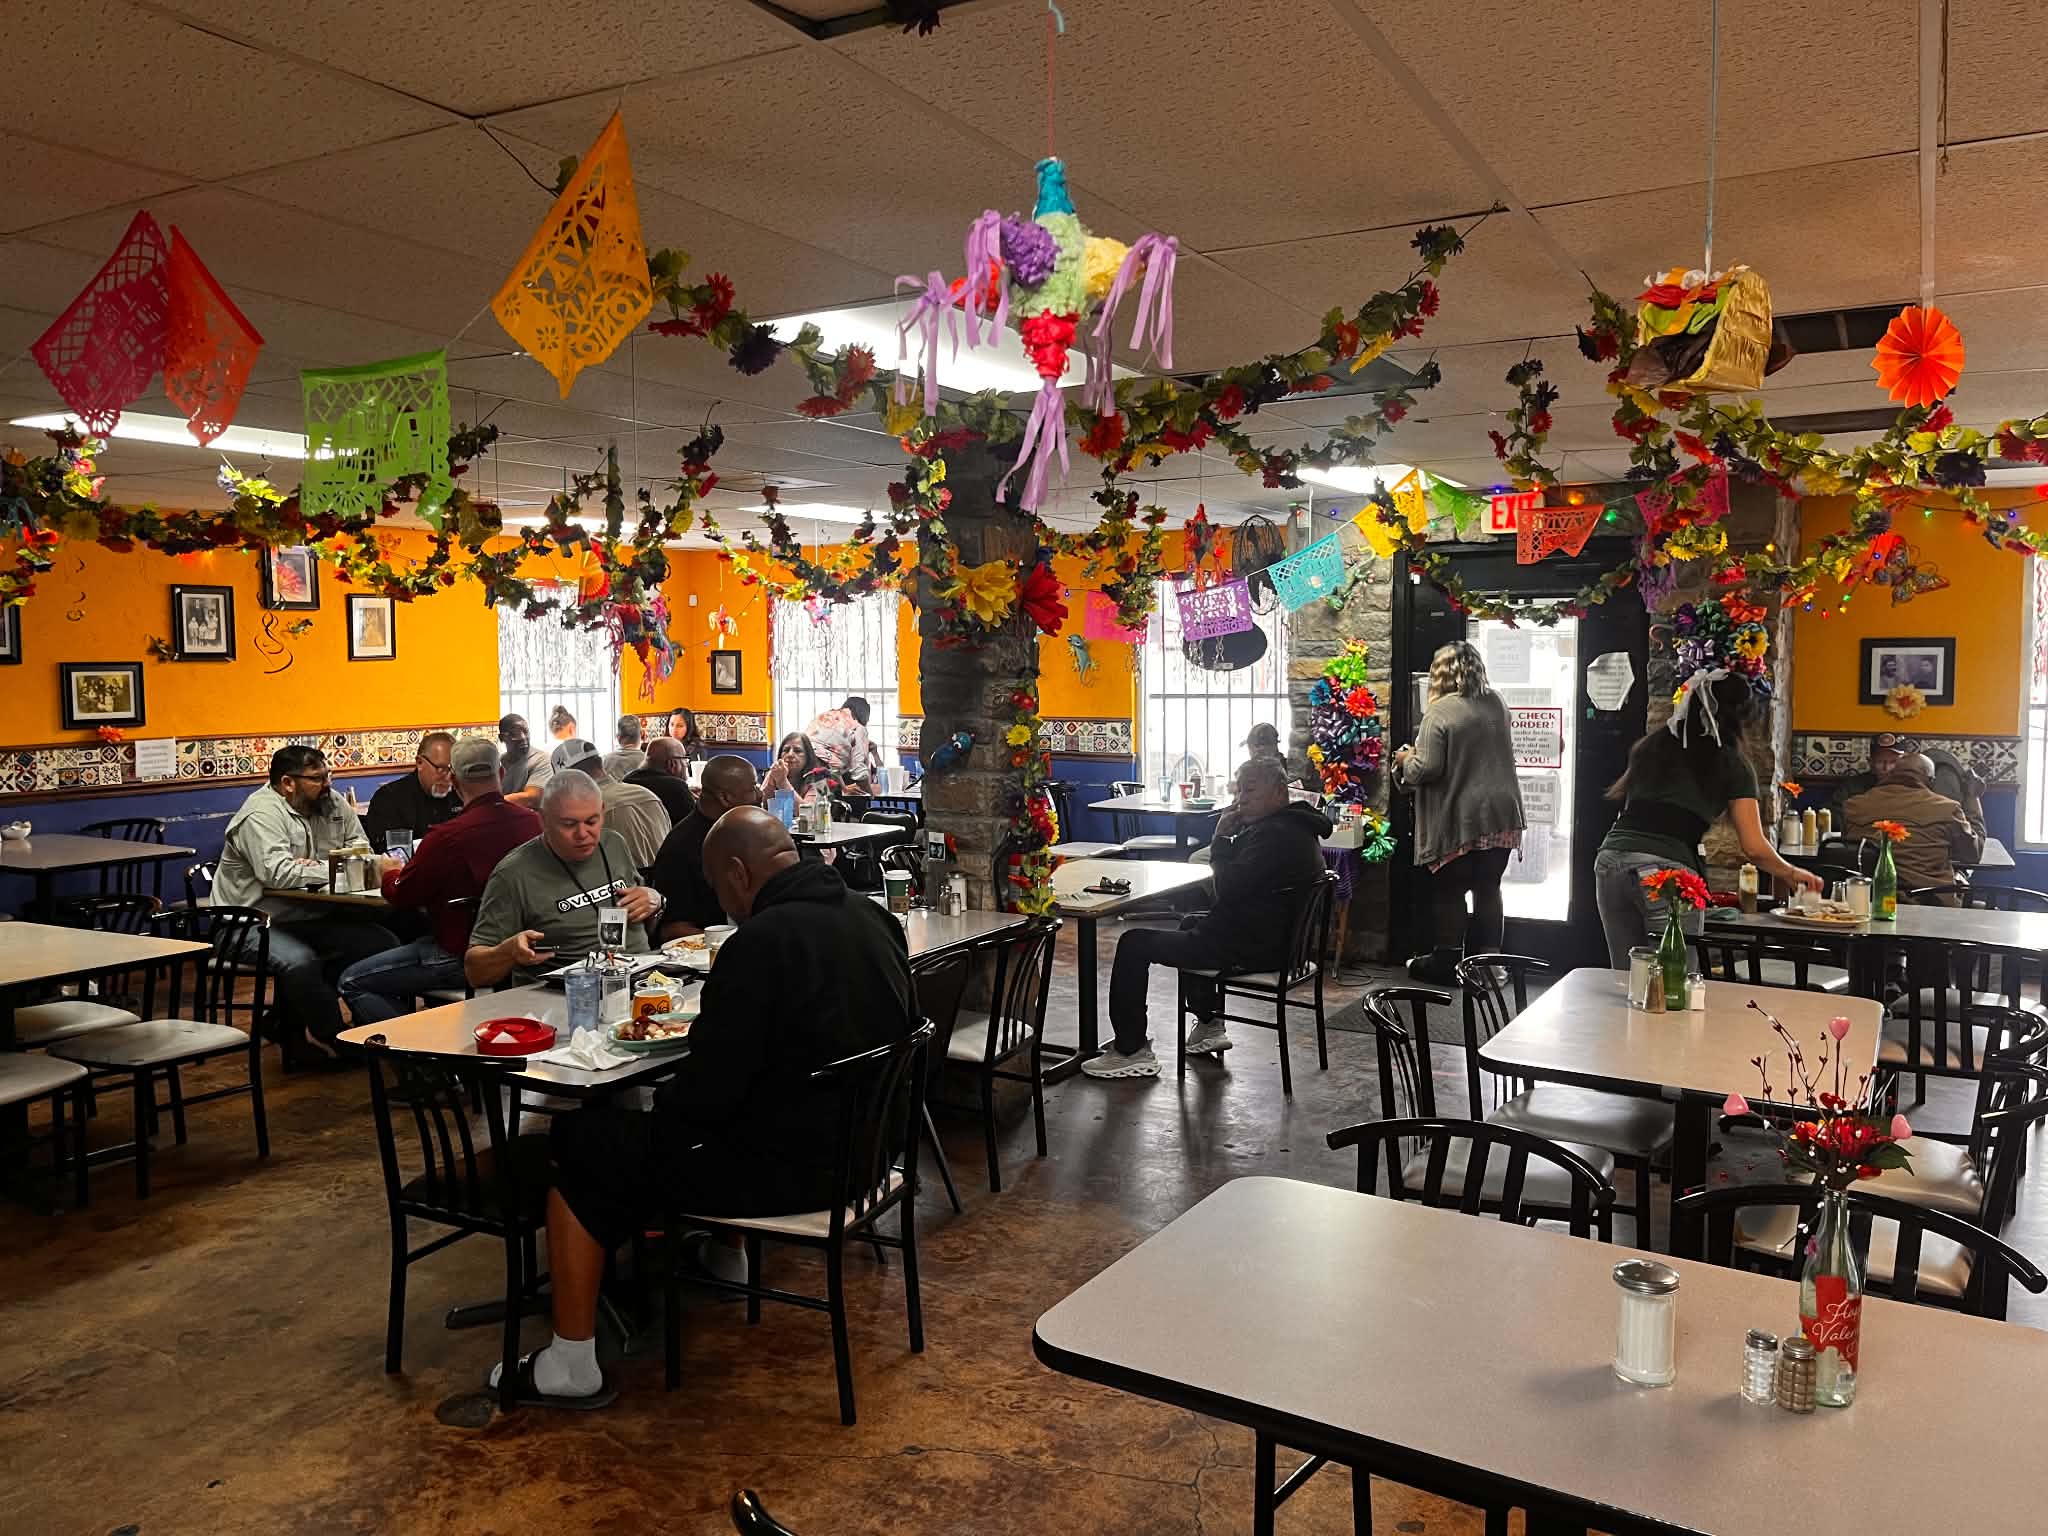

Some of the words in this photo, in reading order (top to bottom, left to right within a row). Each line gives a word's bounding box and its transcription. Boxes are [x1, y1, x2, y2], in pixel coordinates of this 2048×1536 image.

[1518, 712, 1556, 720] CHECK
[1511, 720, 1554, 729] ORDER!
[1523, 756, 1550, 764] YOU!
[571, 881, 625, 905] VOLCOM
[1823, 1297, 1859, 1324] Hap
[1812, 1322, 1857, 1344] Vale
